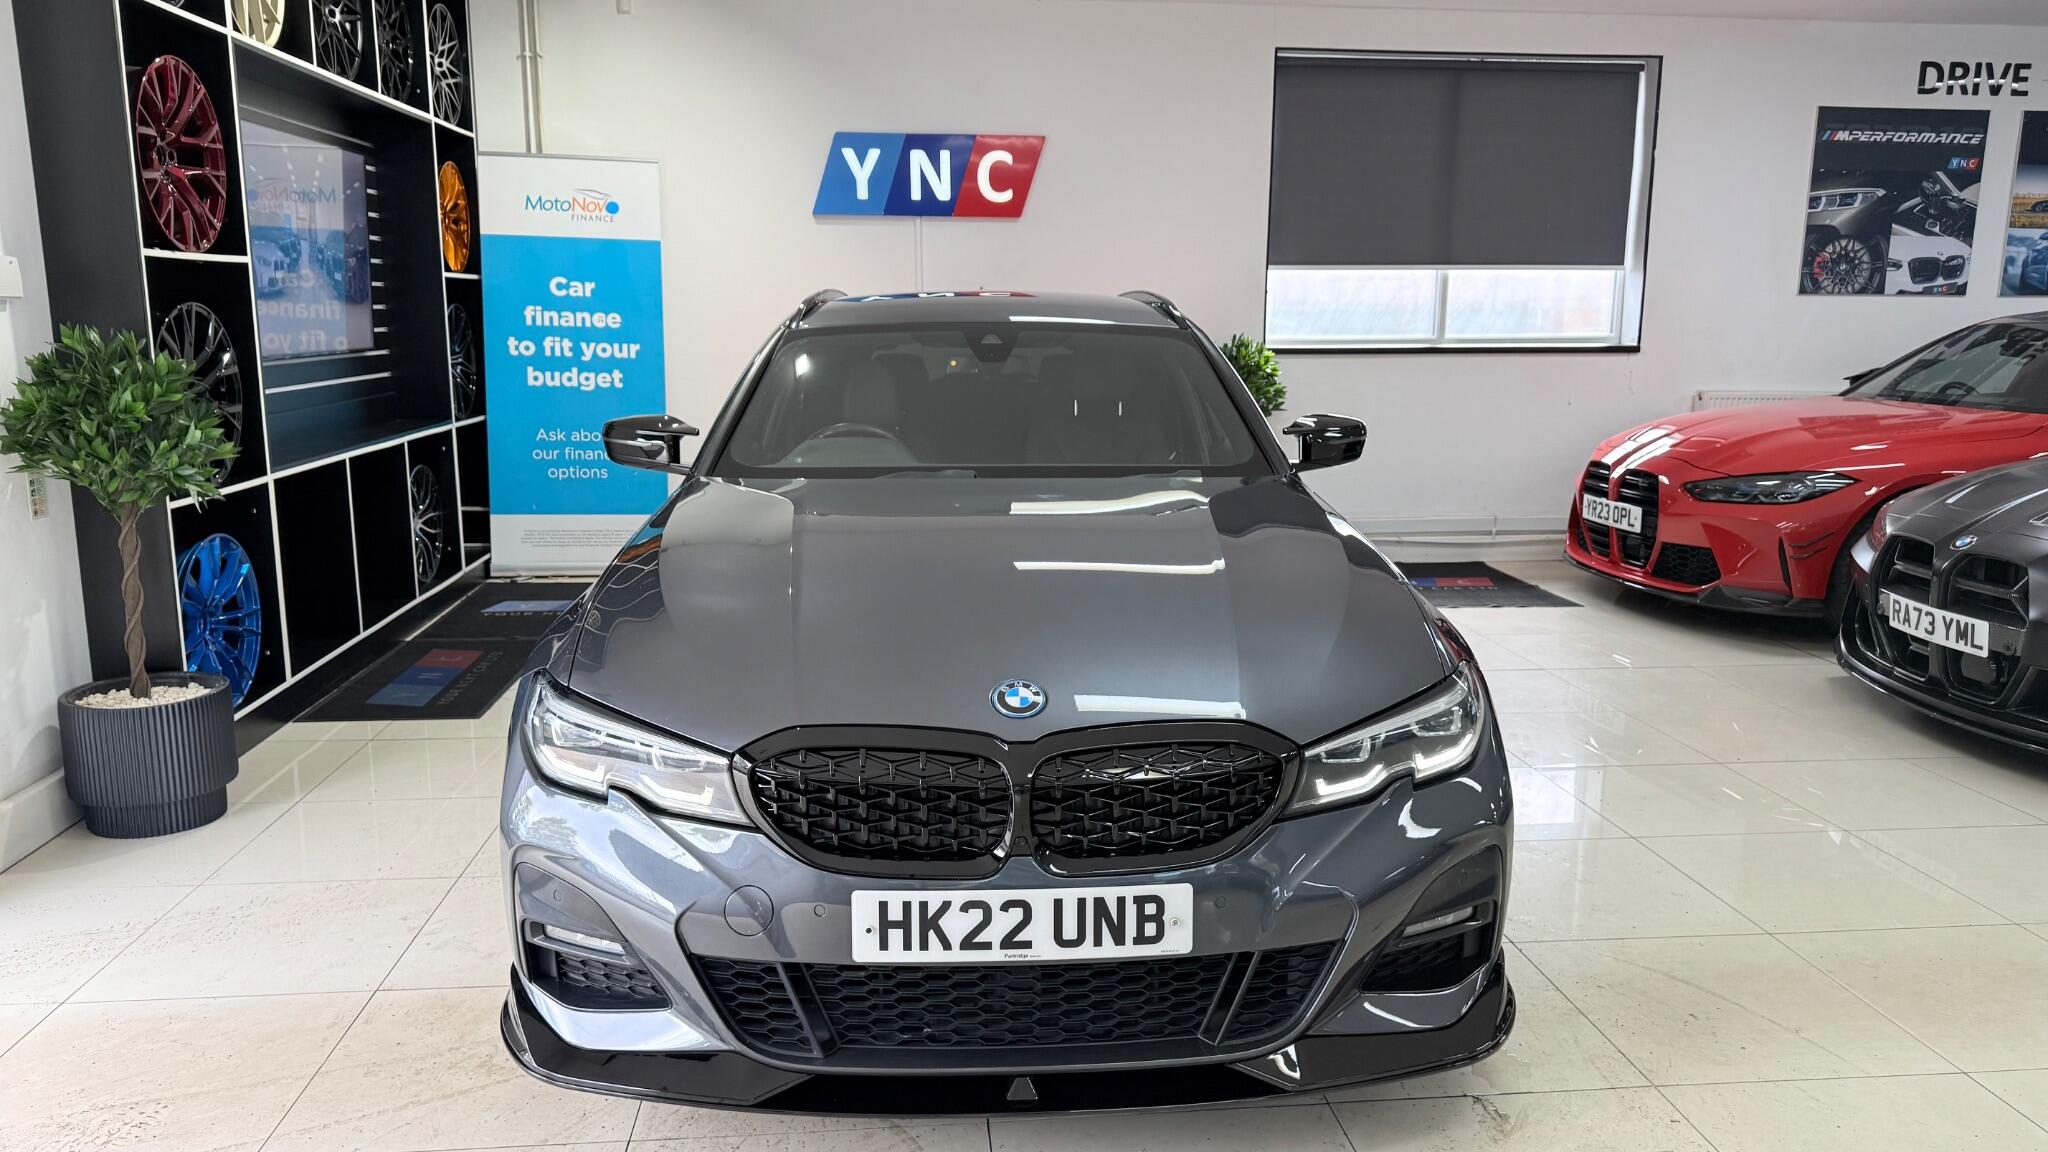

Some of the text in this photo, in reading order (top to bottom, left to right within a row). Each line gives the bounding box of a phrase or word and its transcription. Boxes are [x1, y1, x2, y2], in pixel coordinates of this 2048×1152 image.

[1917, 61, 2032, 96] DRIVE
[1952, 159, 1977, 168] YNC
[841, 147, 1014, 204] YNC
[571, 213, 615, 223] FINANCE
[549, 276, 596, 297] Car
[524, 306, 622, 328] finance
[507, 336, 641, 361] to fit your
[527, 366, 623, 391] budget
[536, 428, 602, 442] Ask abo
[532, 447, 609, 460] our finan
[548, 466, 609, 480] options
[1587, 498, 1635, 528] YR23 OPL
[1892, 598, 1984, 651] RA73 YML
[878, 894, 1166, 952] HK22 UNB
